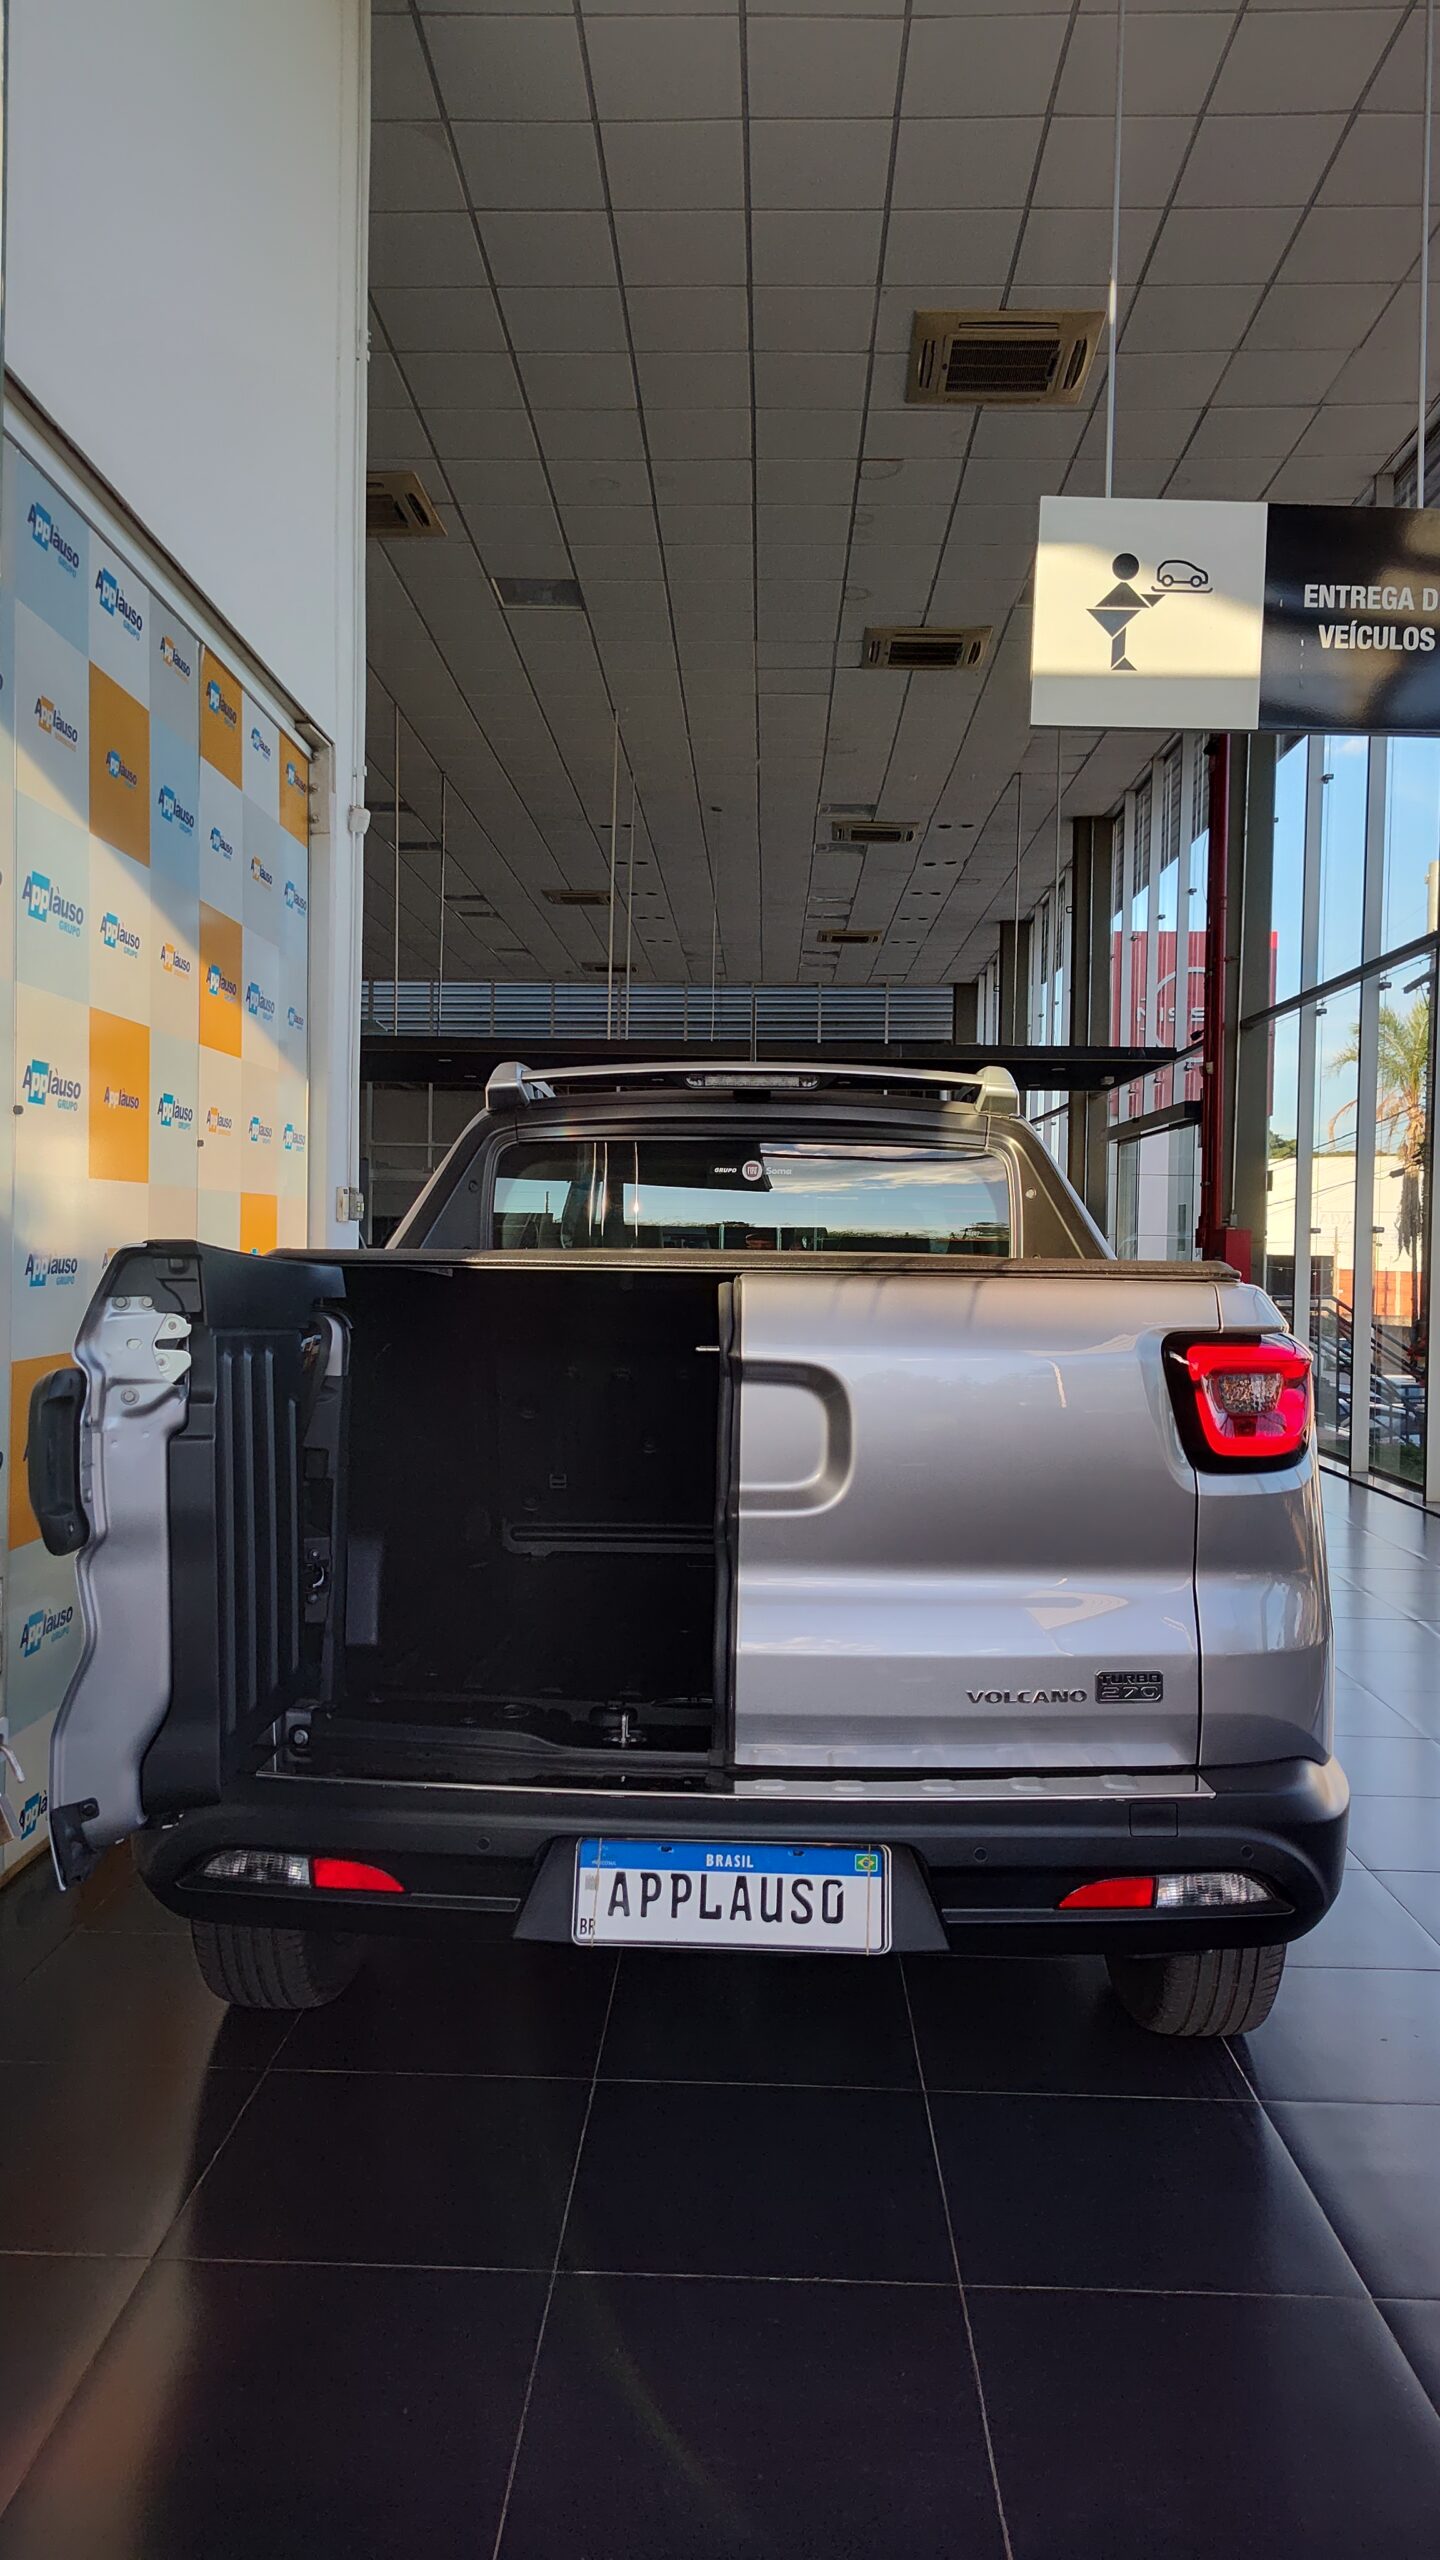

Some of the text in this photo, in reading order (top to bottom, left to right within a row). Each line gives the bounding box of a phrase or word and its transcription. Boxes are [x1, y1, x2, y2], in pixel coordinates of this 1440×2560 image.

[1304, 584, 1415, 611] ENTREGA
[1318, 621, 1436, 652] VEÍCULOS
[59, 919, 81, 938] GRUPO
[57, 1098, 78, 1112] GRUPO
[766, 1166, 792, 1175] Soma
[1099, 1674, 1161, 1685] TURBO
[966, 1690, 1087, 1704] VOLCANO
[706, 1854, 754, 1868] BRASIL
